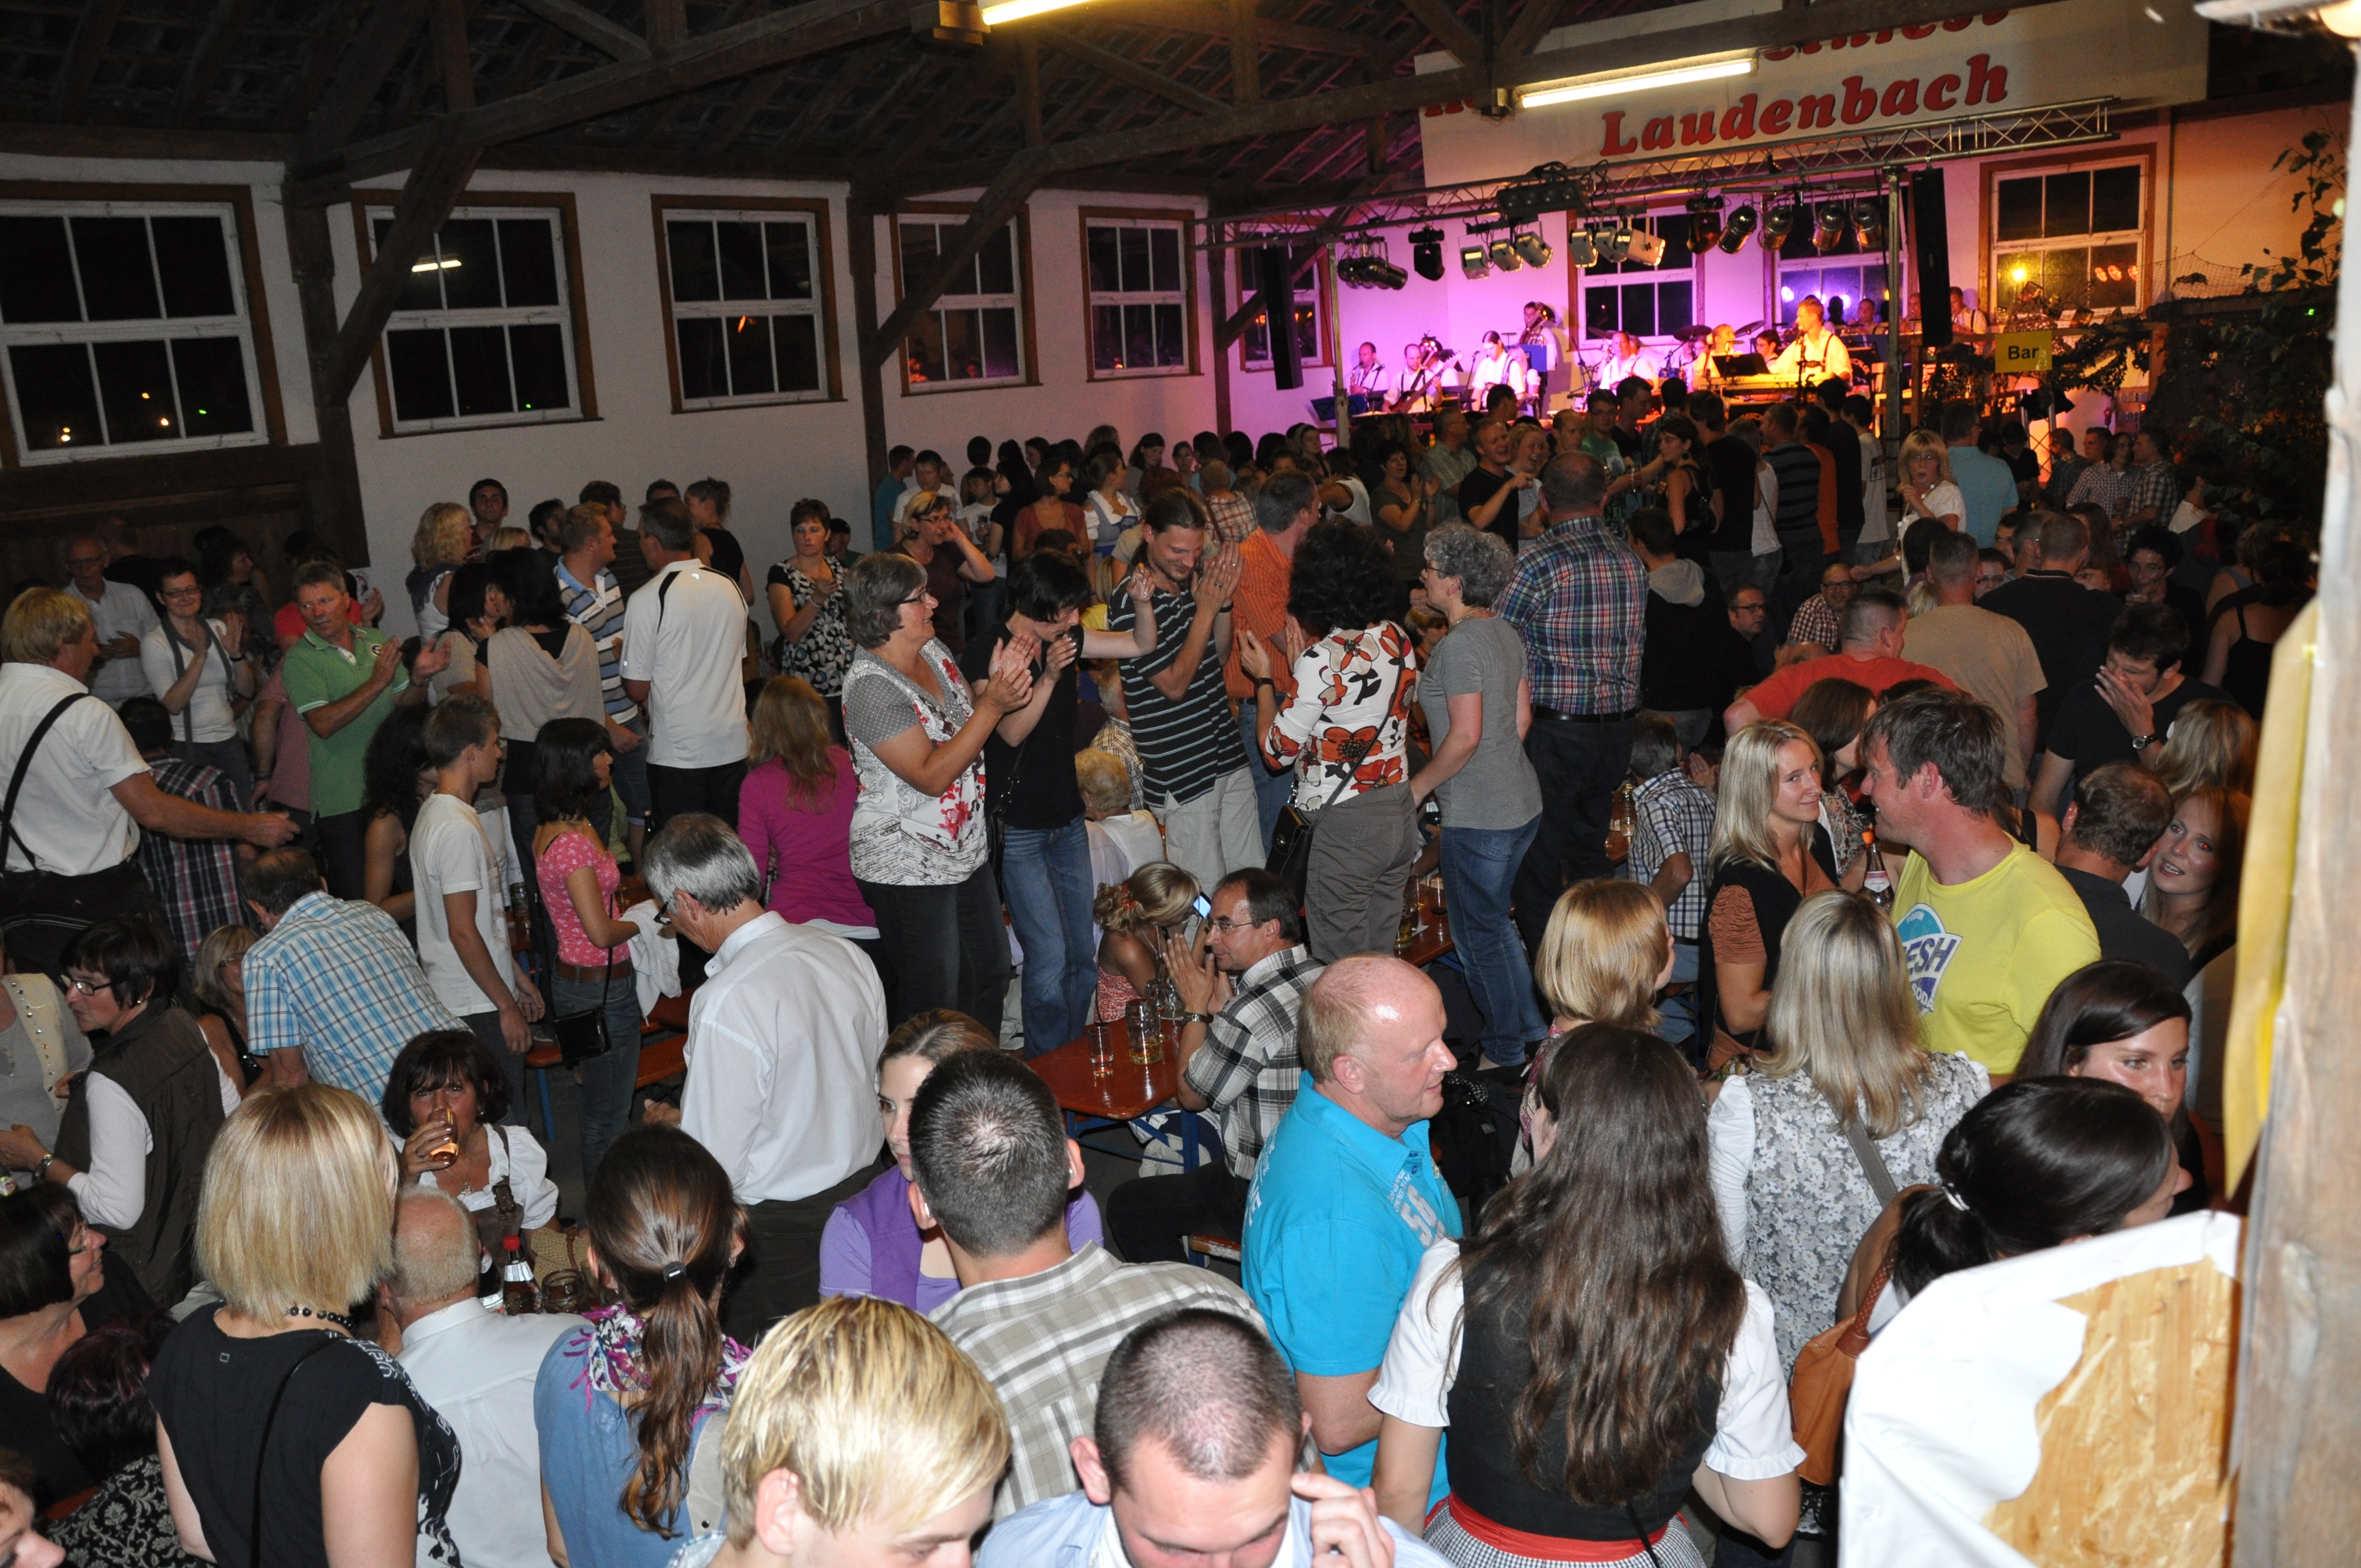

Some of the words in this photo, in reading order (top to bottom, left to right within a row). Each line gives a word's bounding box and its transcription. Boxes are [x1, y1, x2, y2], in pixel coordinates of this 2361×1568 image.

[1600, 53, 2008, 157] Laudenbach
[2008, 345, 2039, 360] Bar
[1905, 937, 1957, 975] ESH
[1912, 982, 1935, 1010] SODA
